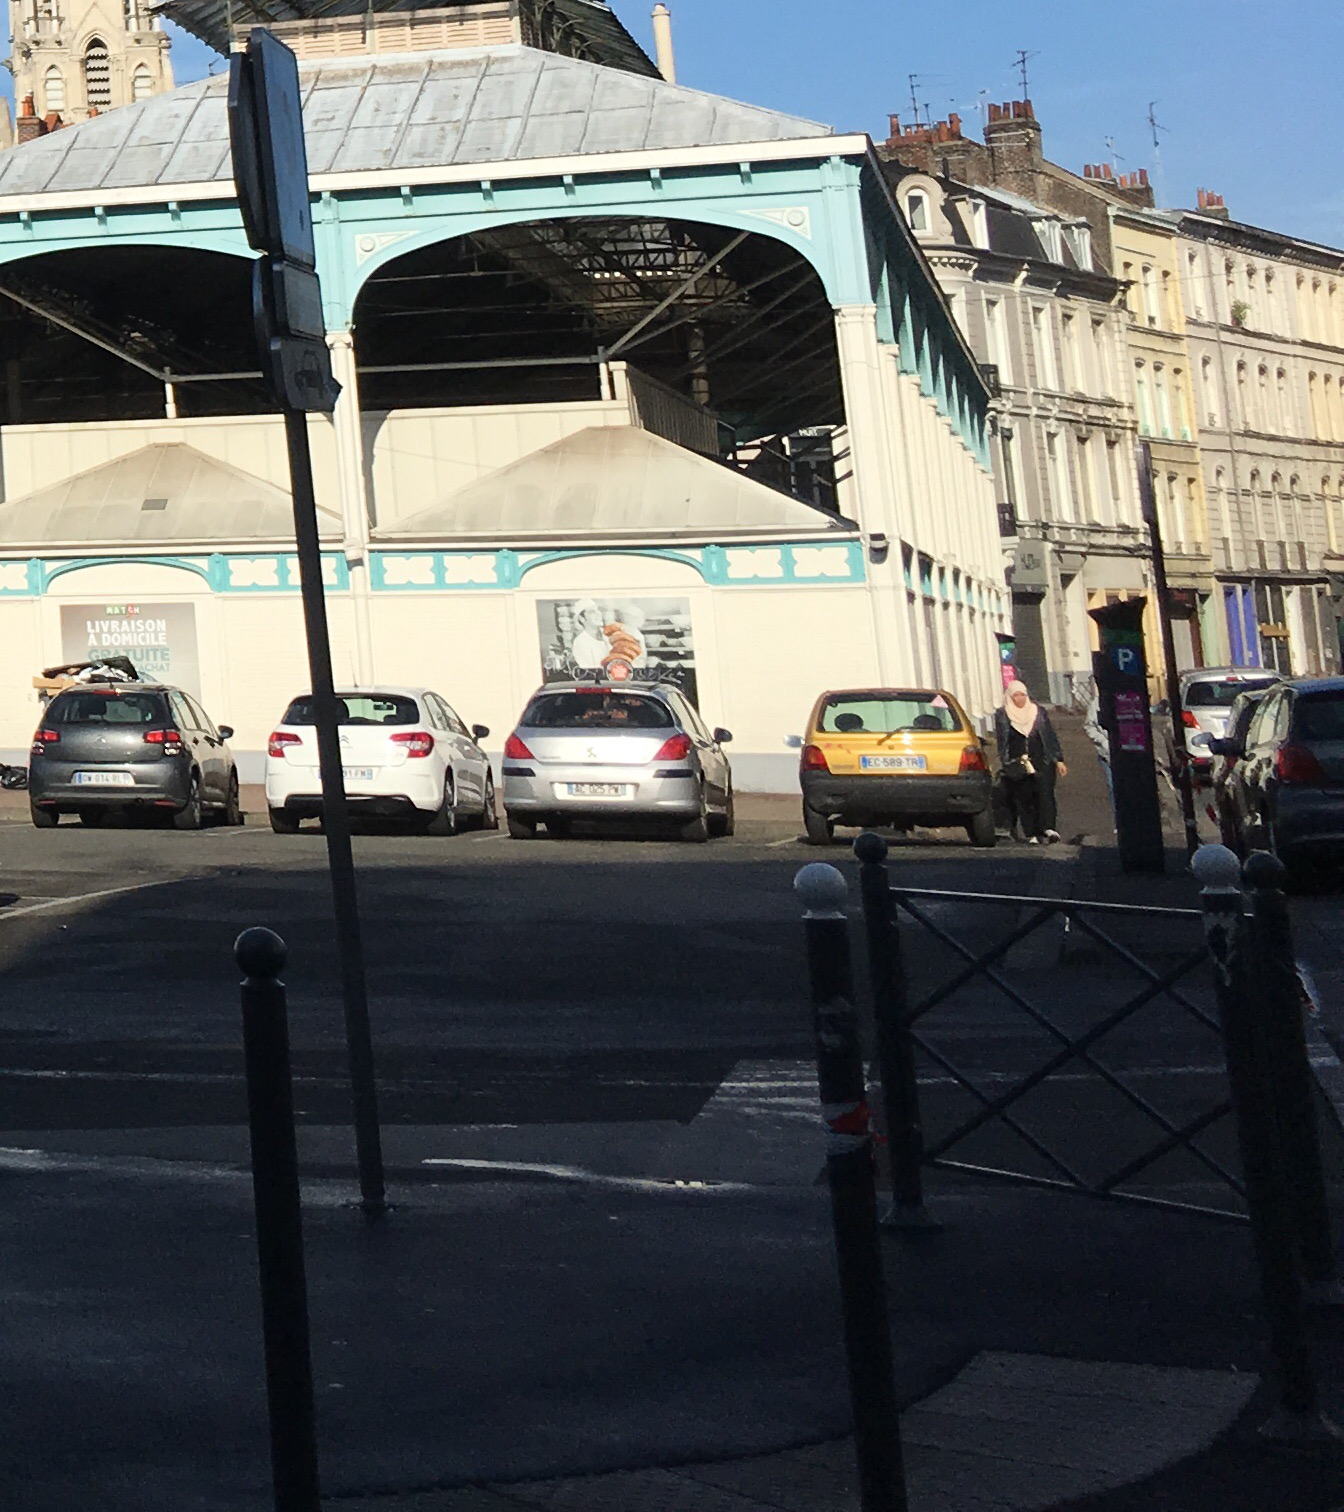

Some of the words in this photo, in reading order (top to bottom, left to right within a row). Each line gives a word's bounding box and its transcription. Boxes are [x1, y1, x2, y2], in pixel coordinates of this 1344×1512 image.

[107, 606, 140, 615] MATCH
[86, 619, 167, 633] LIVRAISON
[101, 632, 168, 646] DOMICILE
[87, 647, 171, 663] GRATUITE
